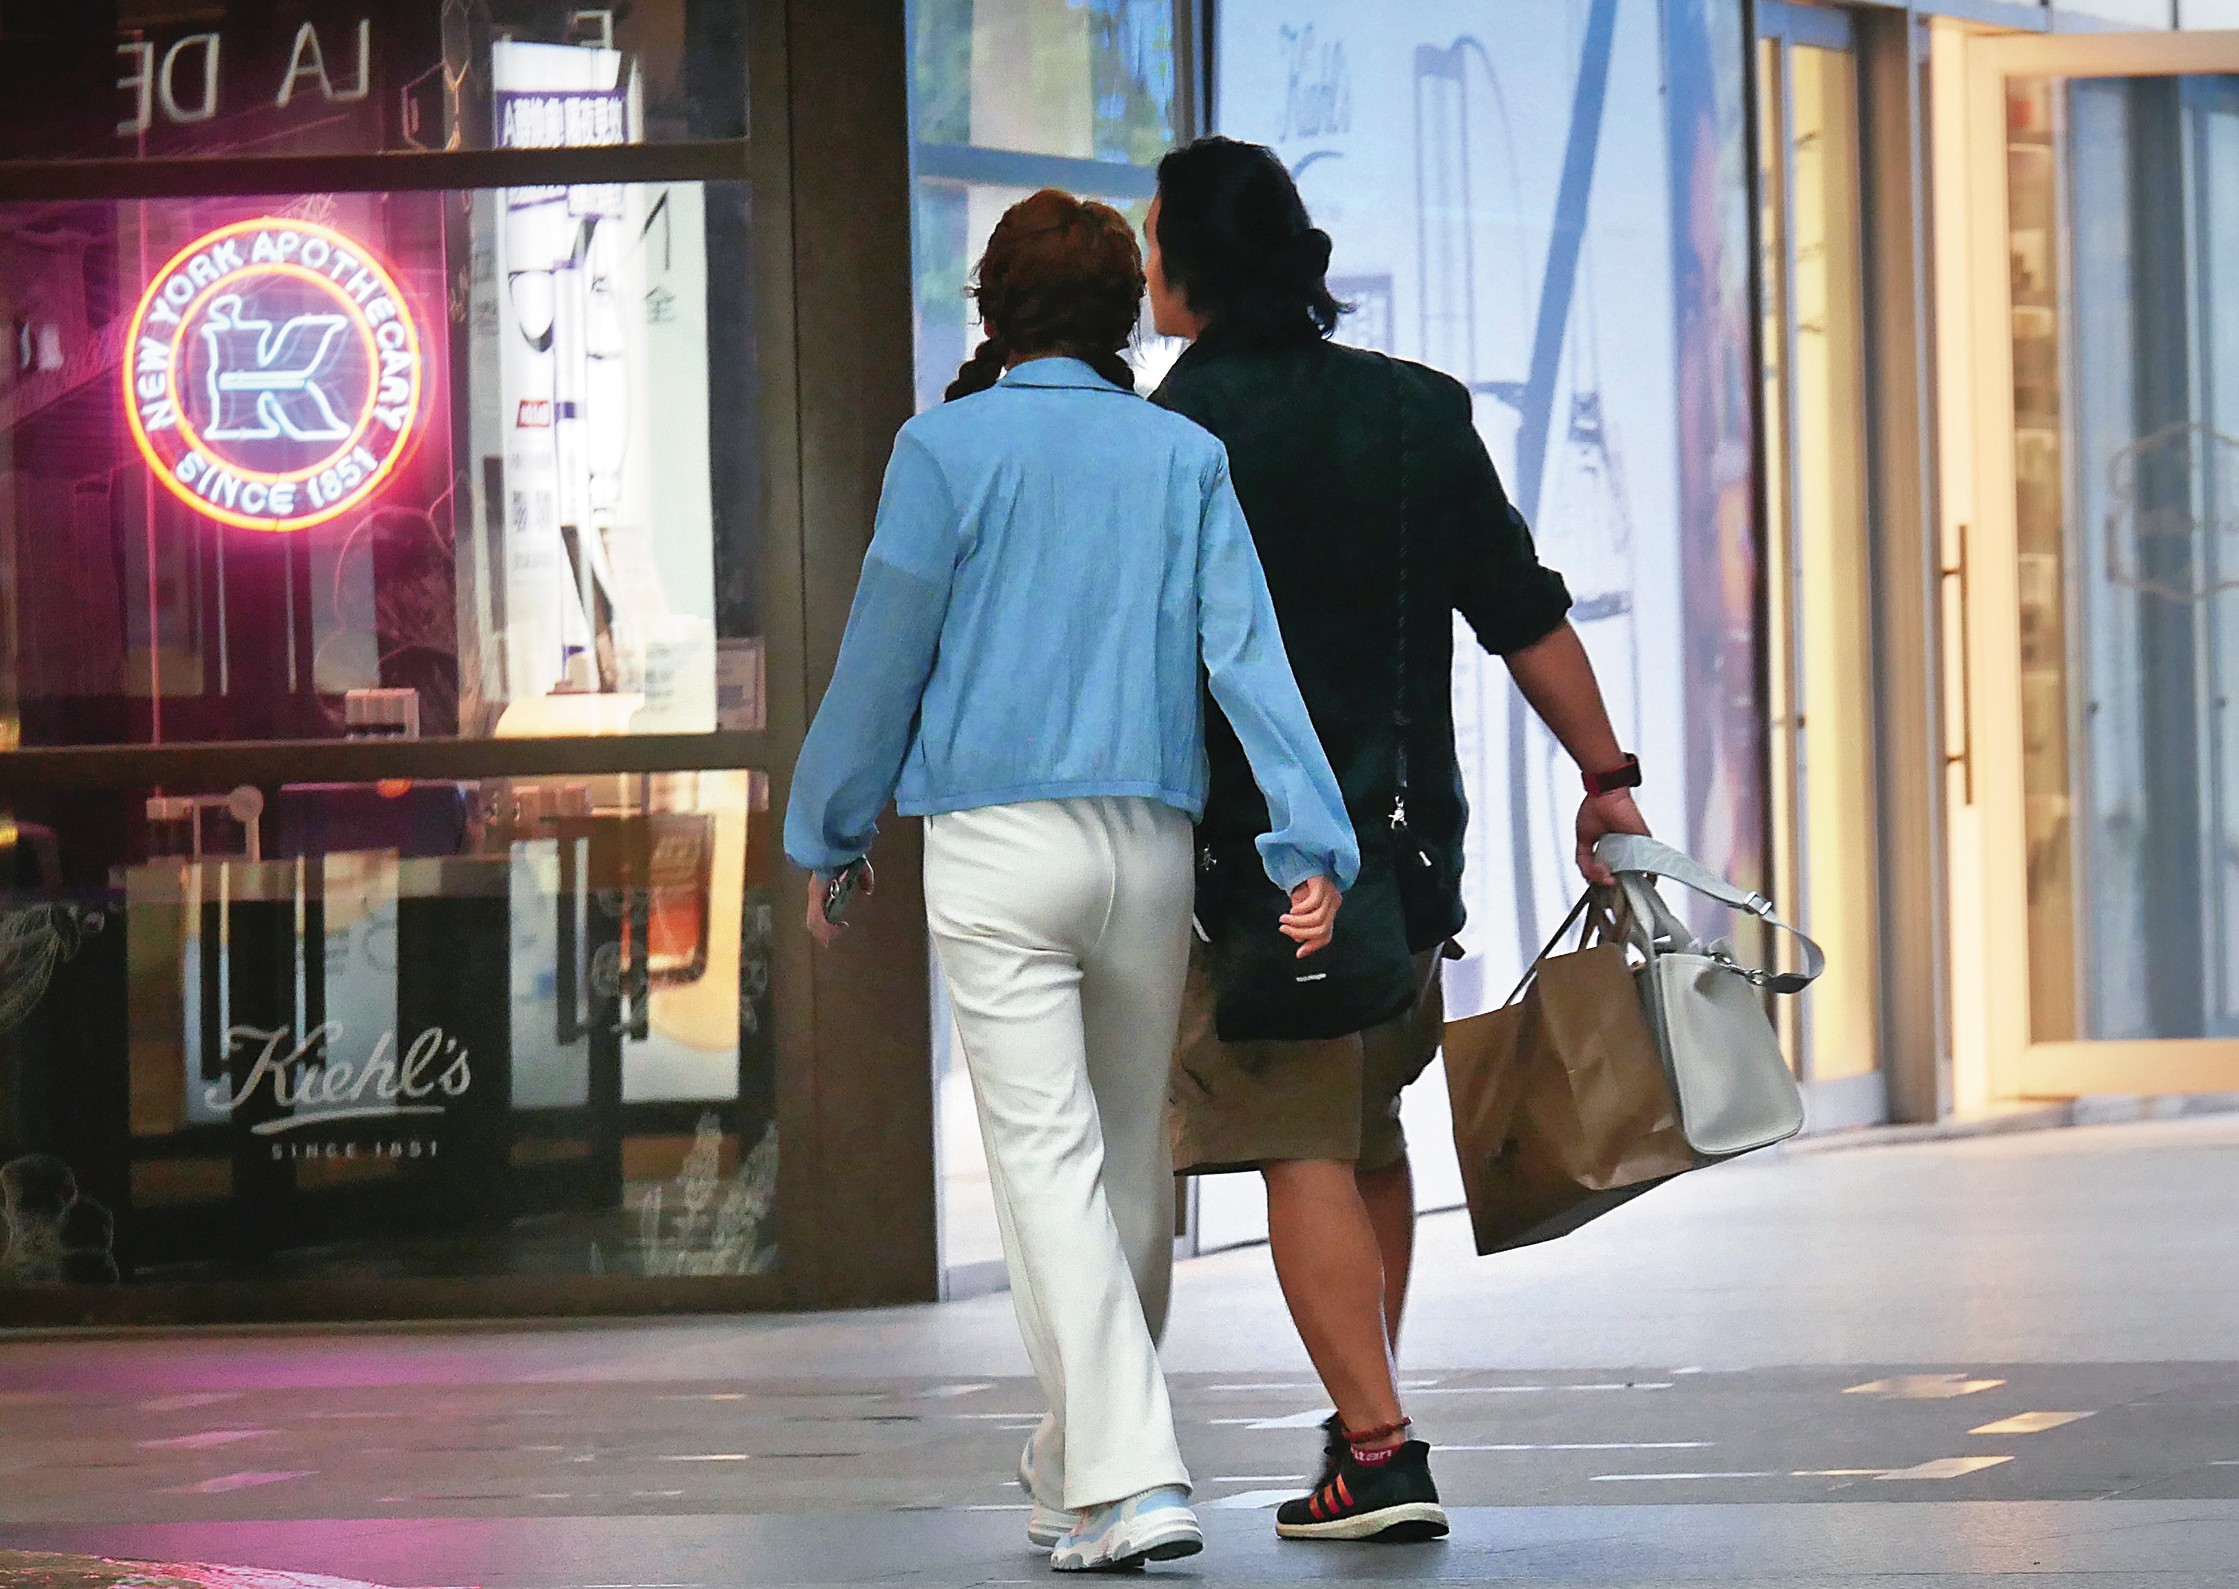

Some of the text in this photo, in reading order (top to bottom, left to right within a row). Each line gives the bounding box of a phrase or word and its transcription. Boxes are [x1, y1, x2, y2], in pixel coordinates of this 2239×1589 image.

[149, 237, 244, 326] YORK
[250, 230, 414, 431] APOTHECARY
[137, 336, 178, 432] NEW
[175, 445, 379, 514] SINCE 1851
[204, 1019, 471, 1112] Kiehl's
[271, 1142, 358, 1160] SINCE
